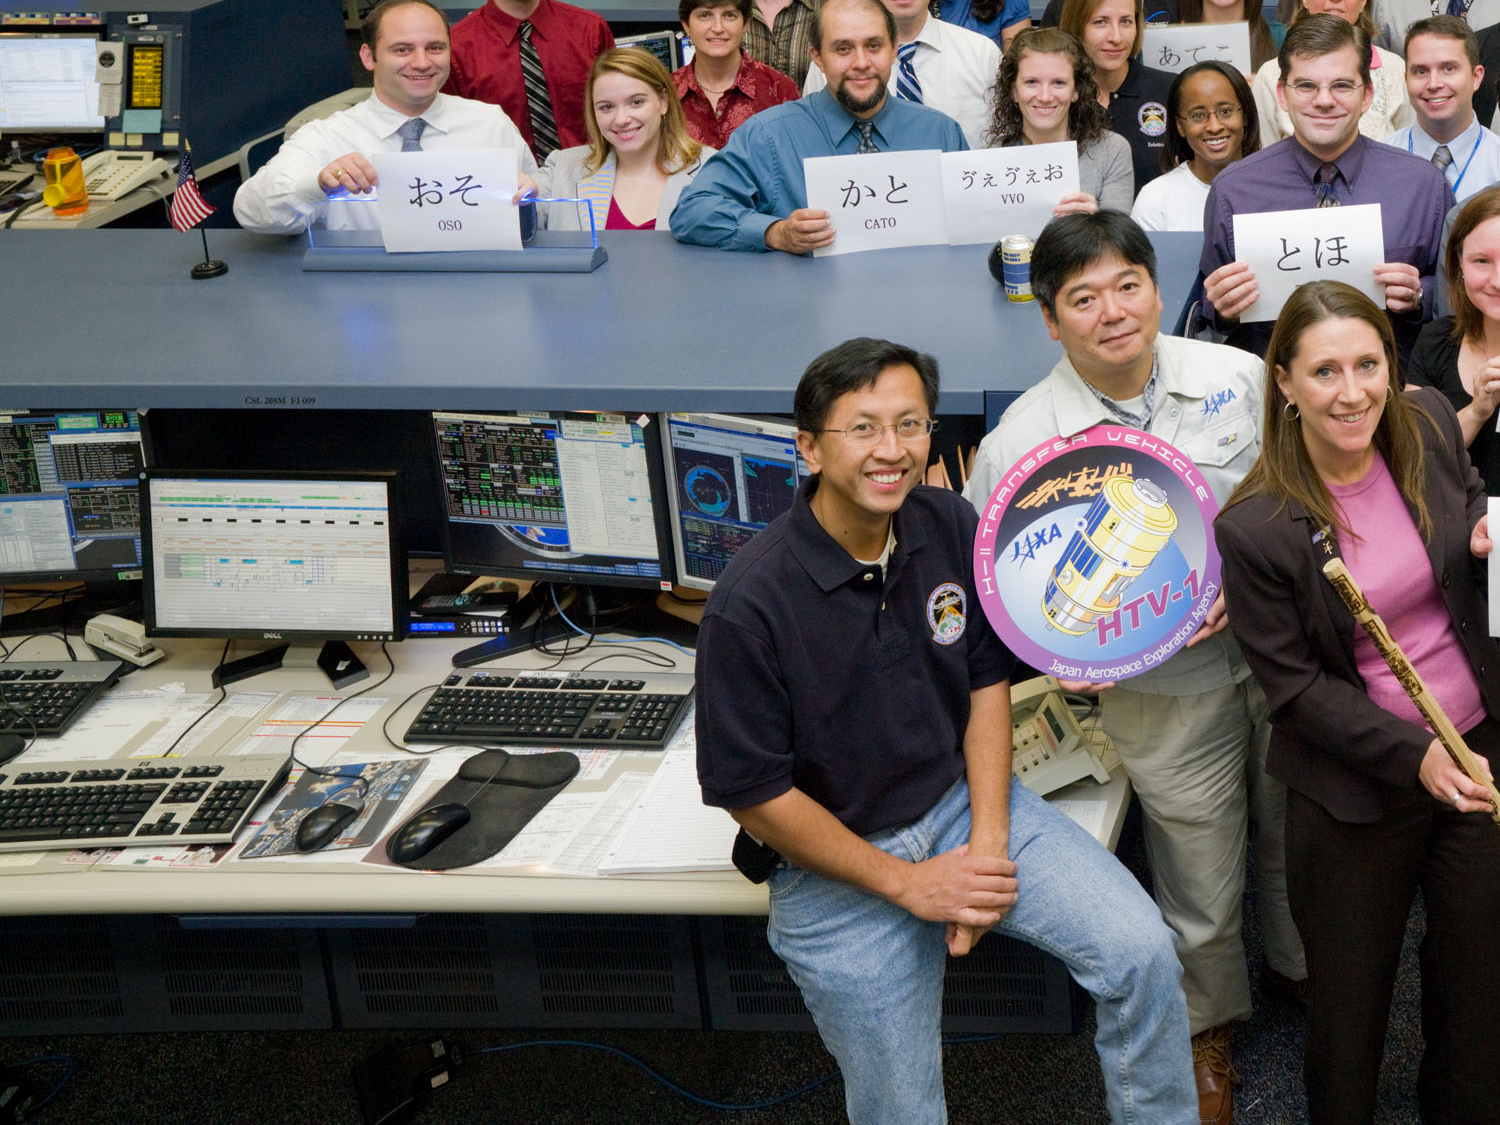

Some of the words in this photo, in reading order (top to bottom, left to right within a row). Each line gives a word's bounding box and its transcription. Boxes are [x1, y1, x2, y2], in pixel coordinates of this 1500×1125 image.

[408, 175, 483, 208] おそ
[839, 174, 910, 209] かと
[1001, 192, 1025, 205] VVO
[438, 219, 462, 231] OSO
[864, 216, 897, 231] CATO
[1277, 236, 1350, 271] とほ
[1201, 388, 1237, 423] JAXA
[982, 433, 1088, 538] TRANSFER
[1106, 430, 1209, 503] VEHICLE
[1008, 523, 1063, 572] JAXA
[1096, 568, 1201, 647] HTV-1
[1048, 657, 1082, 679] Japan
[1084, 660, 1143, 681] Aerospace
[1143, 625, 1192, 667] Exploration
[1190, 580, 1218, 626] Agency
